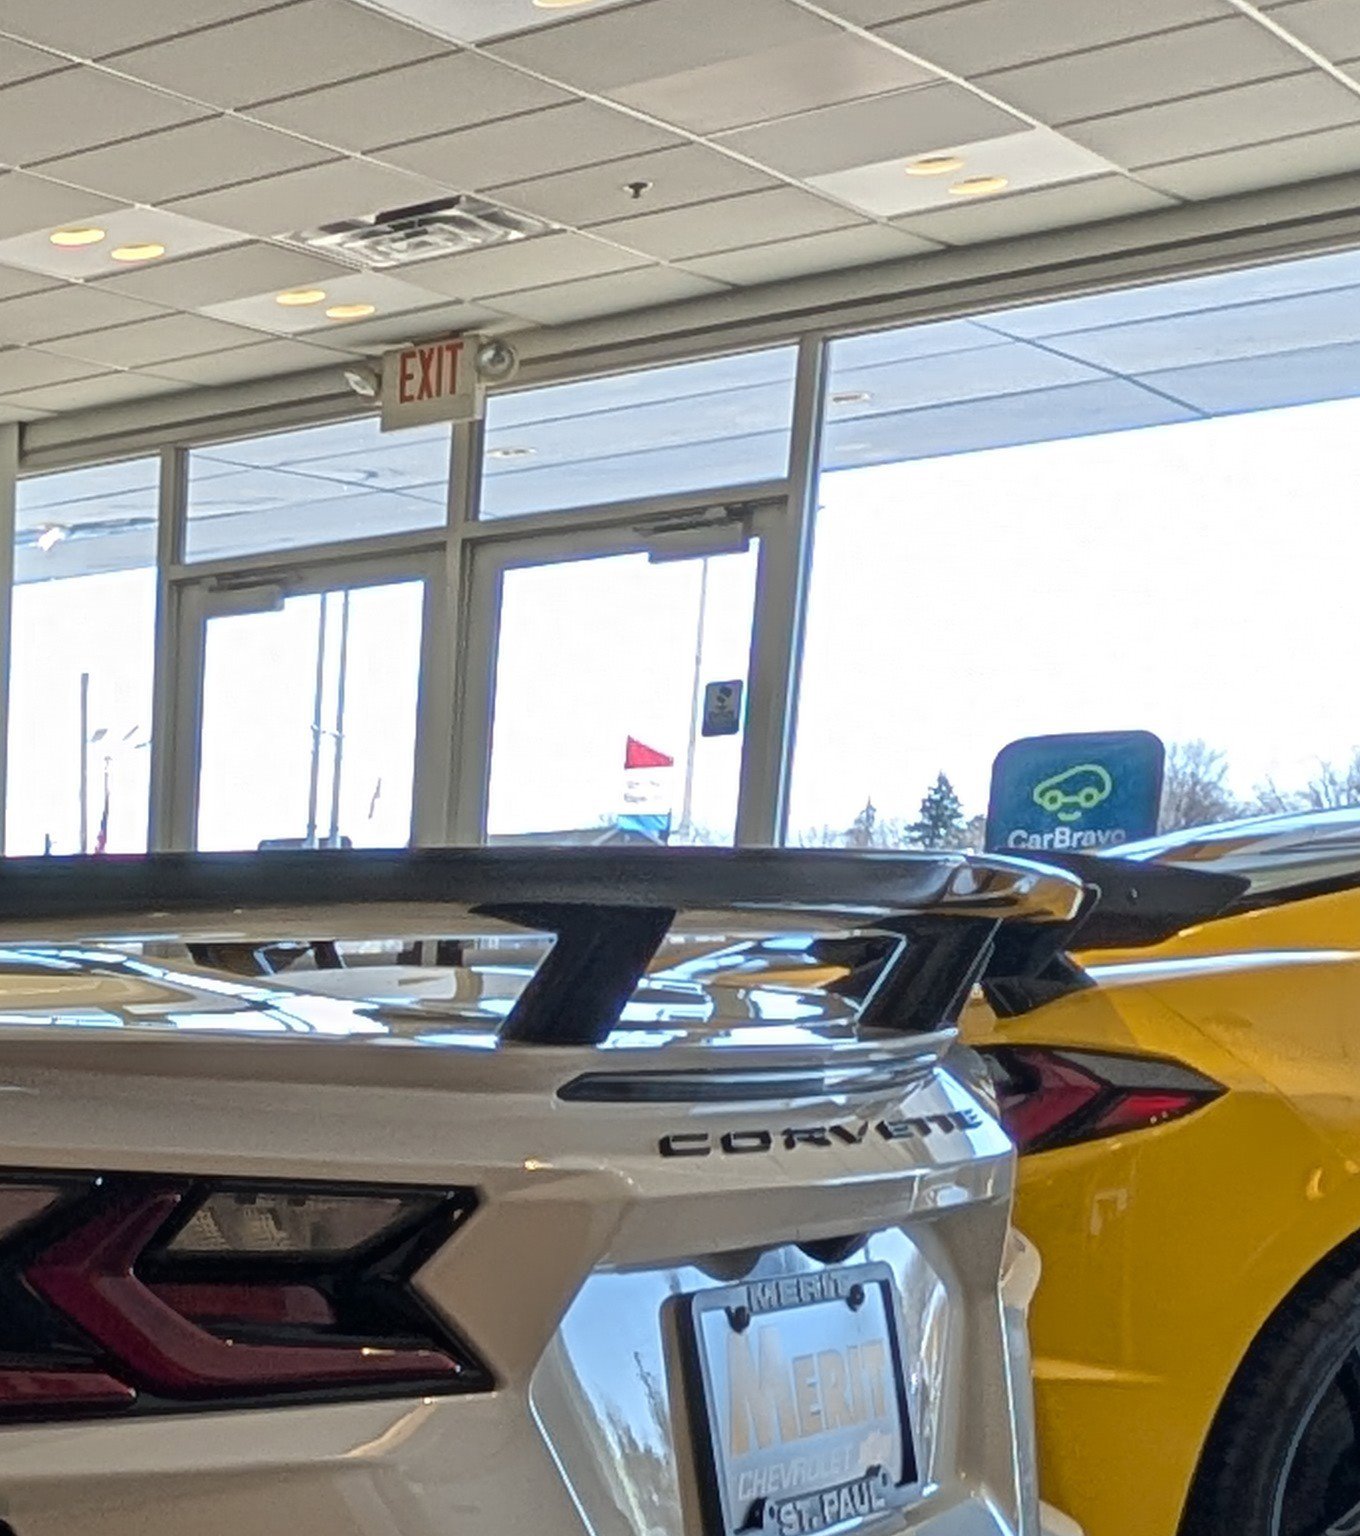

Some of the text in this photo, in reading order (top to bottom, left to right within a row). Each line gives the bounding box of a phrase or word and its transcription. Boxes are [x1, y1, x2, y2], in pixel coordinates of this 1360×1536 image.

[399, 341, 463, 404] EXIT
[1007, 826, 1126, 849] CarBravo
[658, 1108, 982, 1157] CORVETTE
[746, 1272, 852, 1311] MERIT
[737, 1446, 857, 1500] CHEVROLET
[778, 1482, 886, 1536] ST. PAUL
